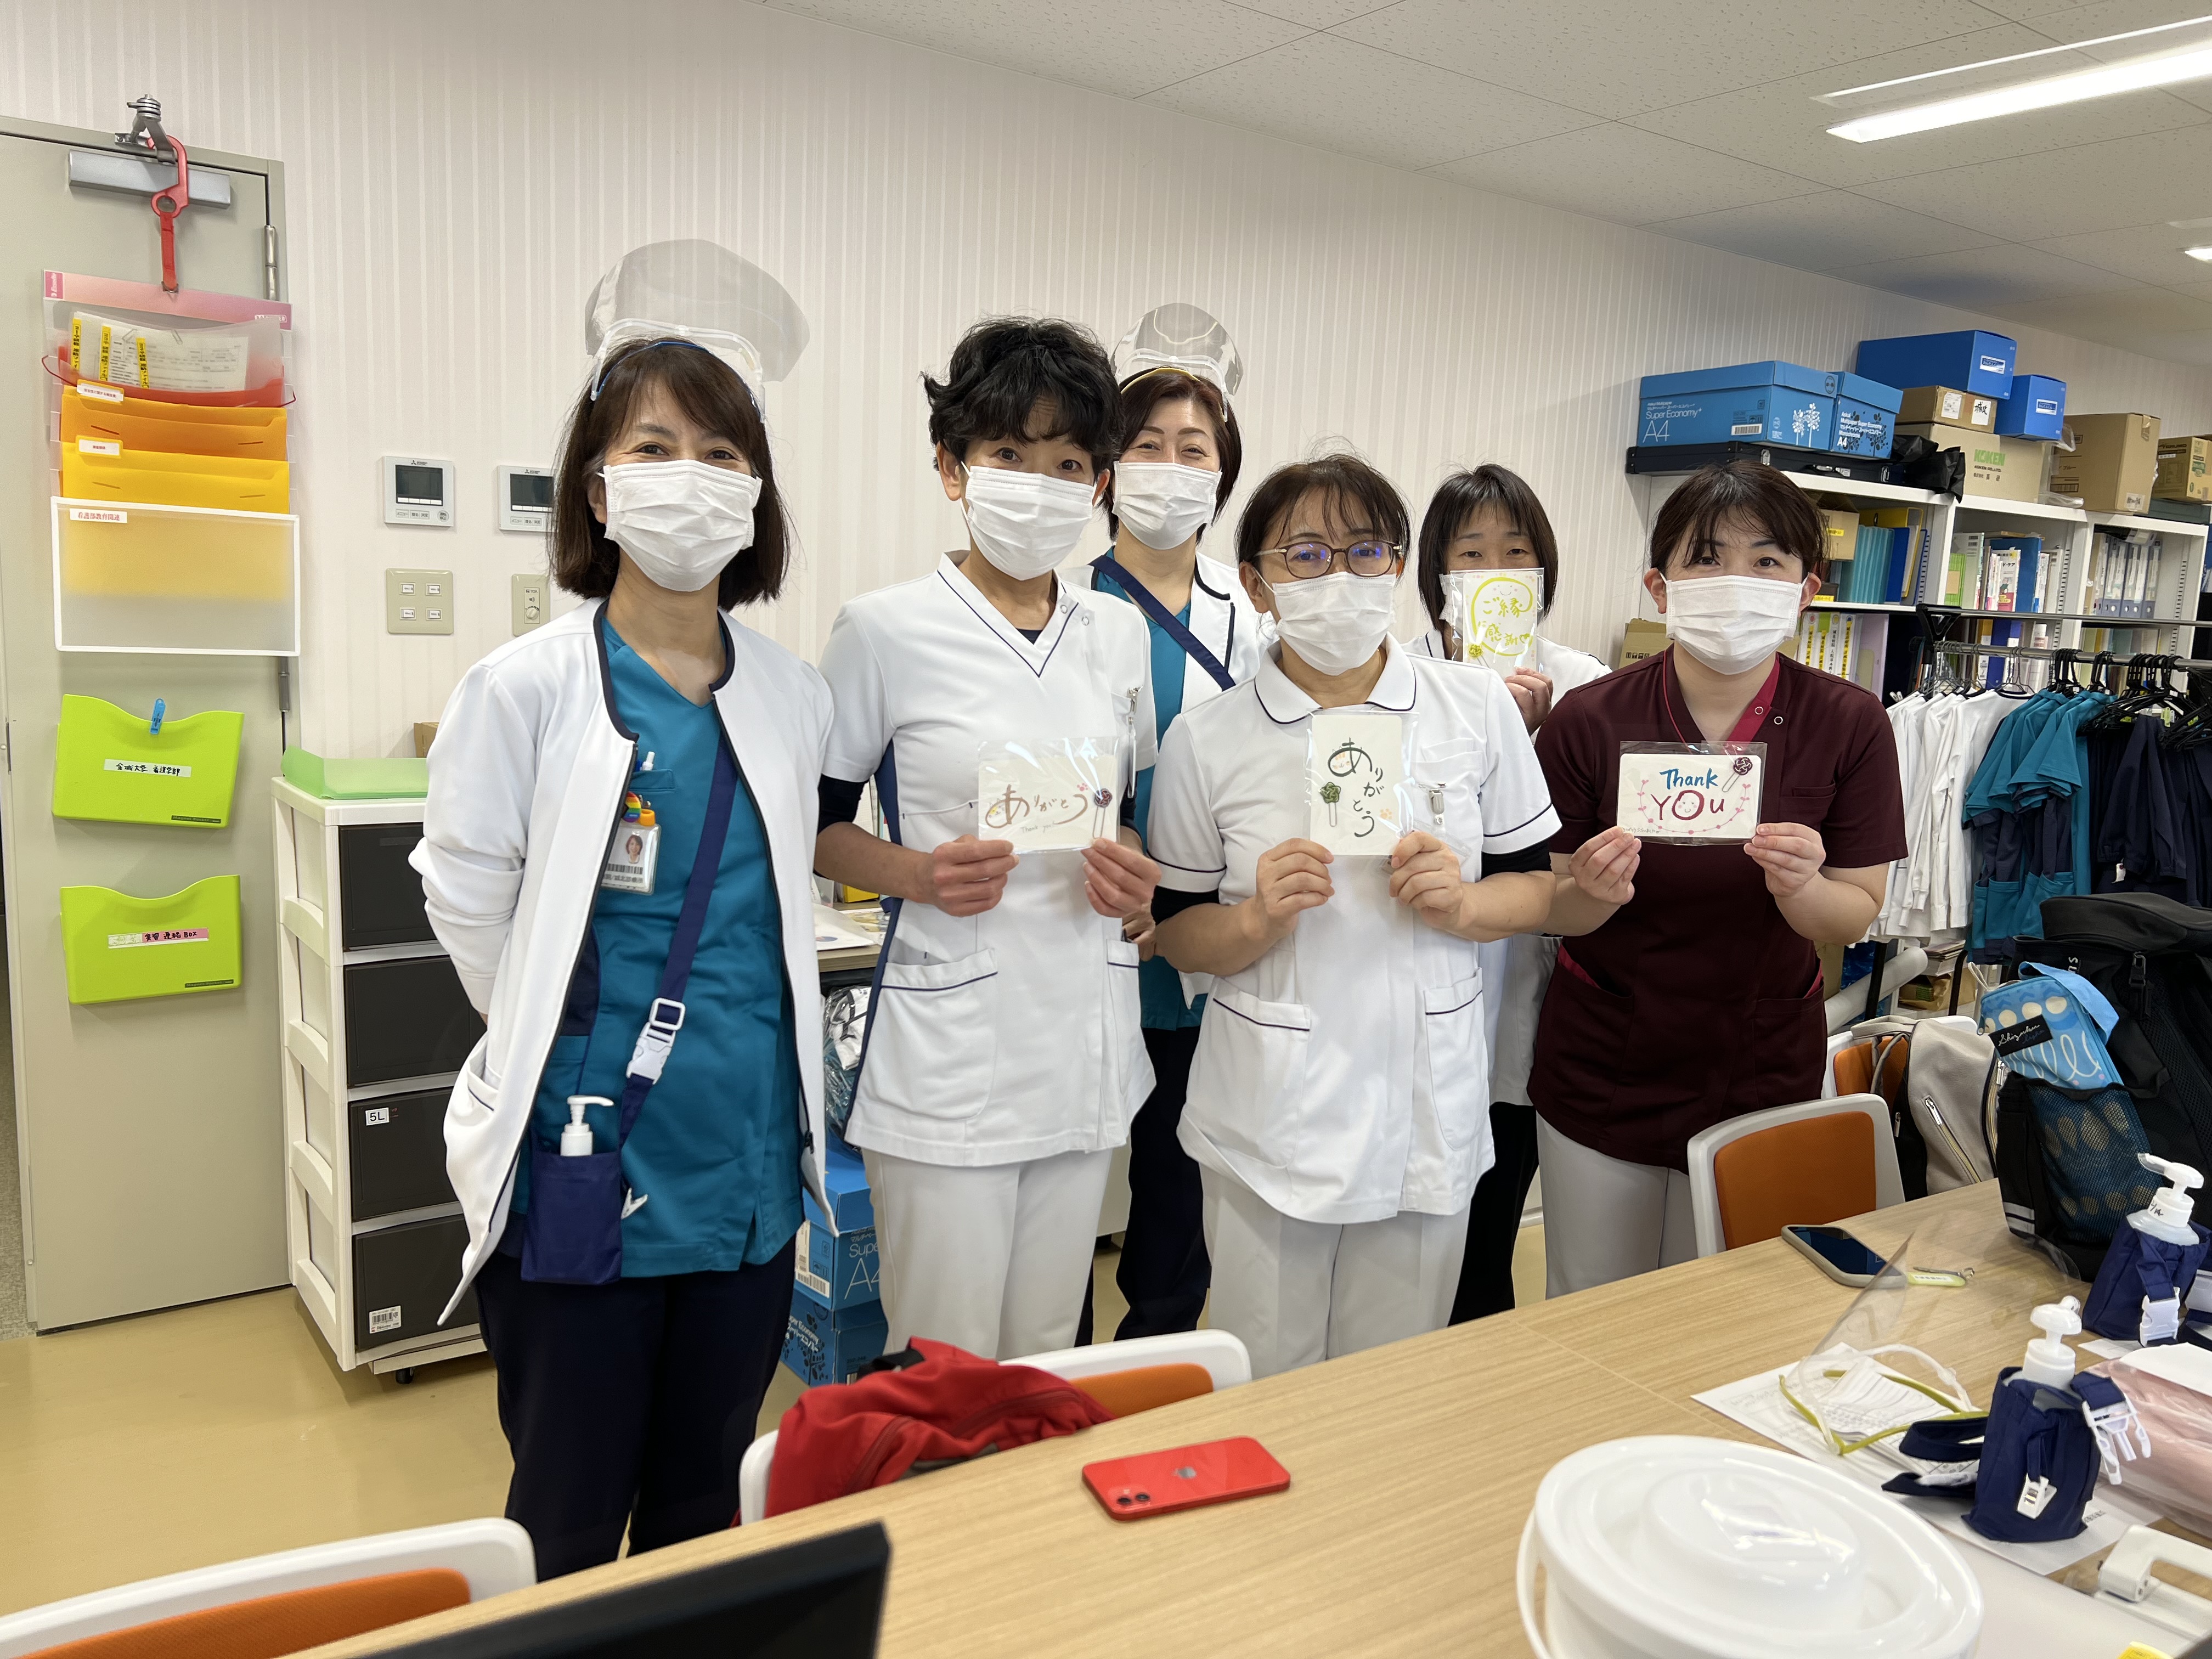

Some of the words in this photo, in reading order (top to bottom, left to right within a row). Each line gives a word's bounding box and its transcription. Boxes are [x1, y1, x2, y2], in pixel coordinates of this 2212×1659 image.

[1646, 411, 1666, 420] Super
[1643, 420, 1670, 443] A4
[1837, 436, 1847, 447] A4
[1974, 449, 2006, 466] KOKEN
[1483, 596, 1523, 618] ご縁
[115, 762, 148, 772] 金城大学
[1328, 737, 1385, 838] ありがとう
[1659, 768, 1719, 790] Thank
[985, 783, 1088, 829] ありがとう
[1020, 825, 1038, 833] Thank
[370, 1111, 386, 1122] 5L
[850, 1232, 876, 1243] マルチペー
[849, 1242, 879, 1259] Supe
